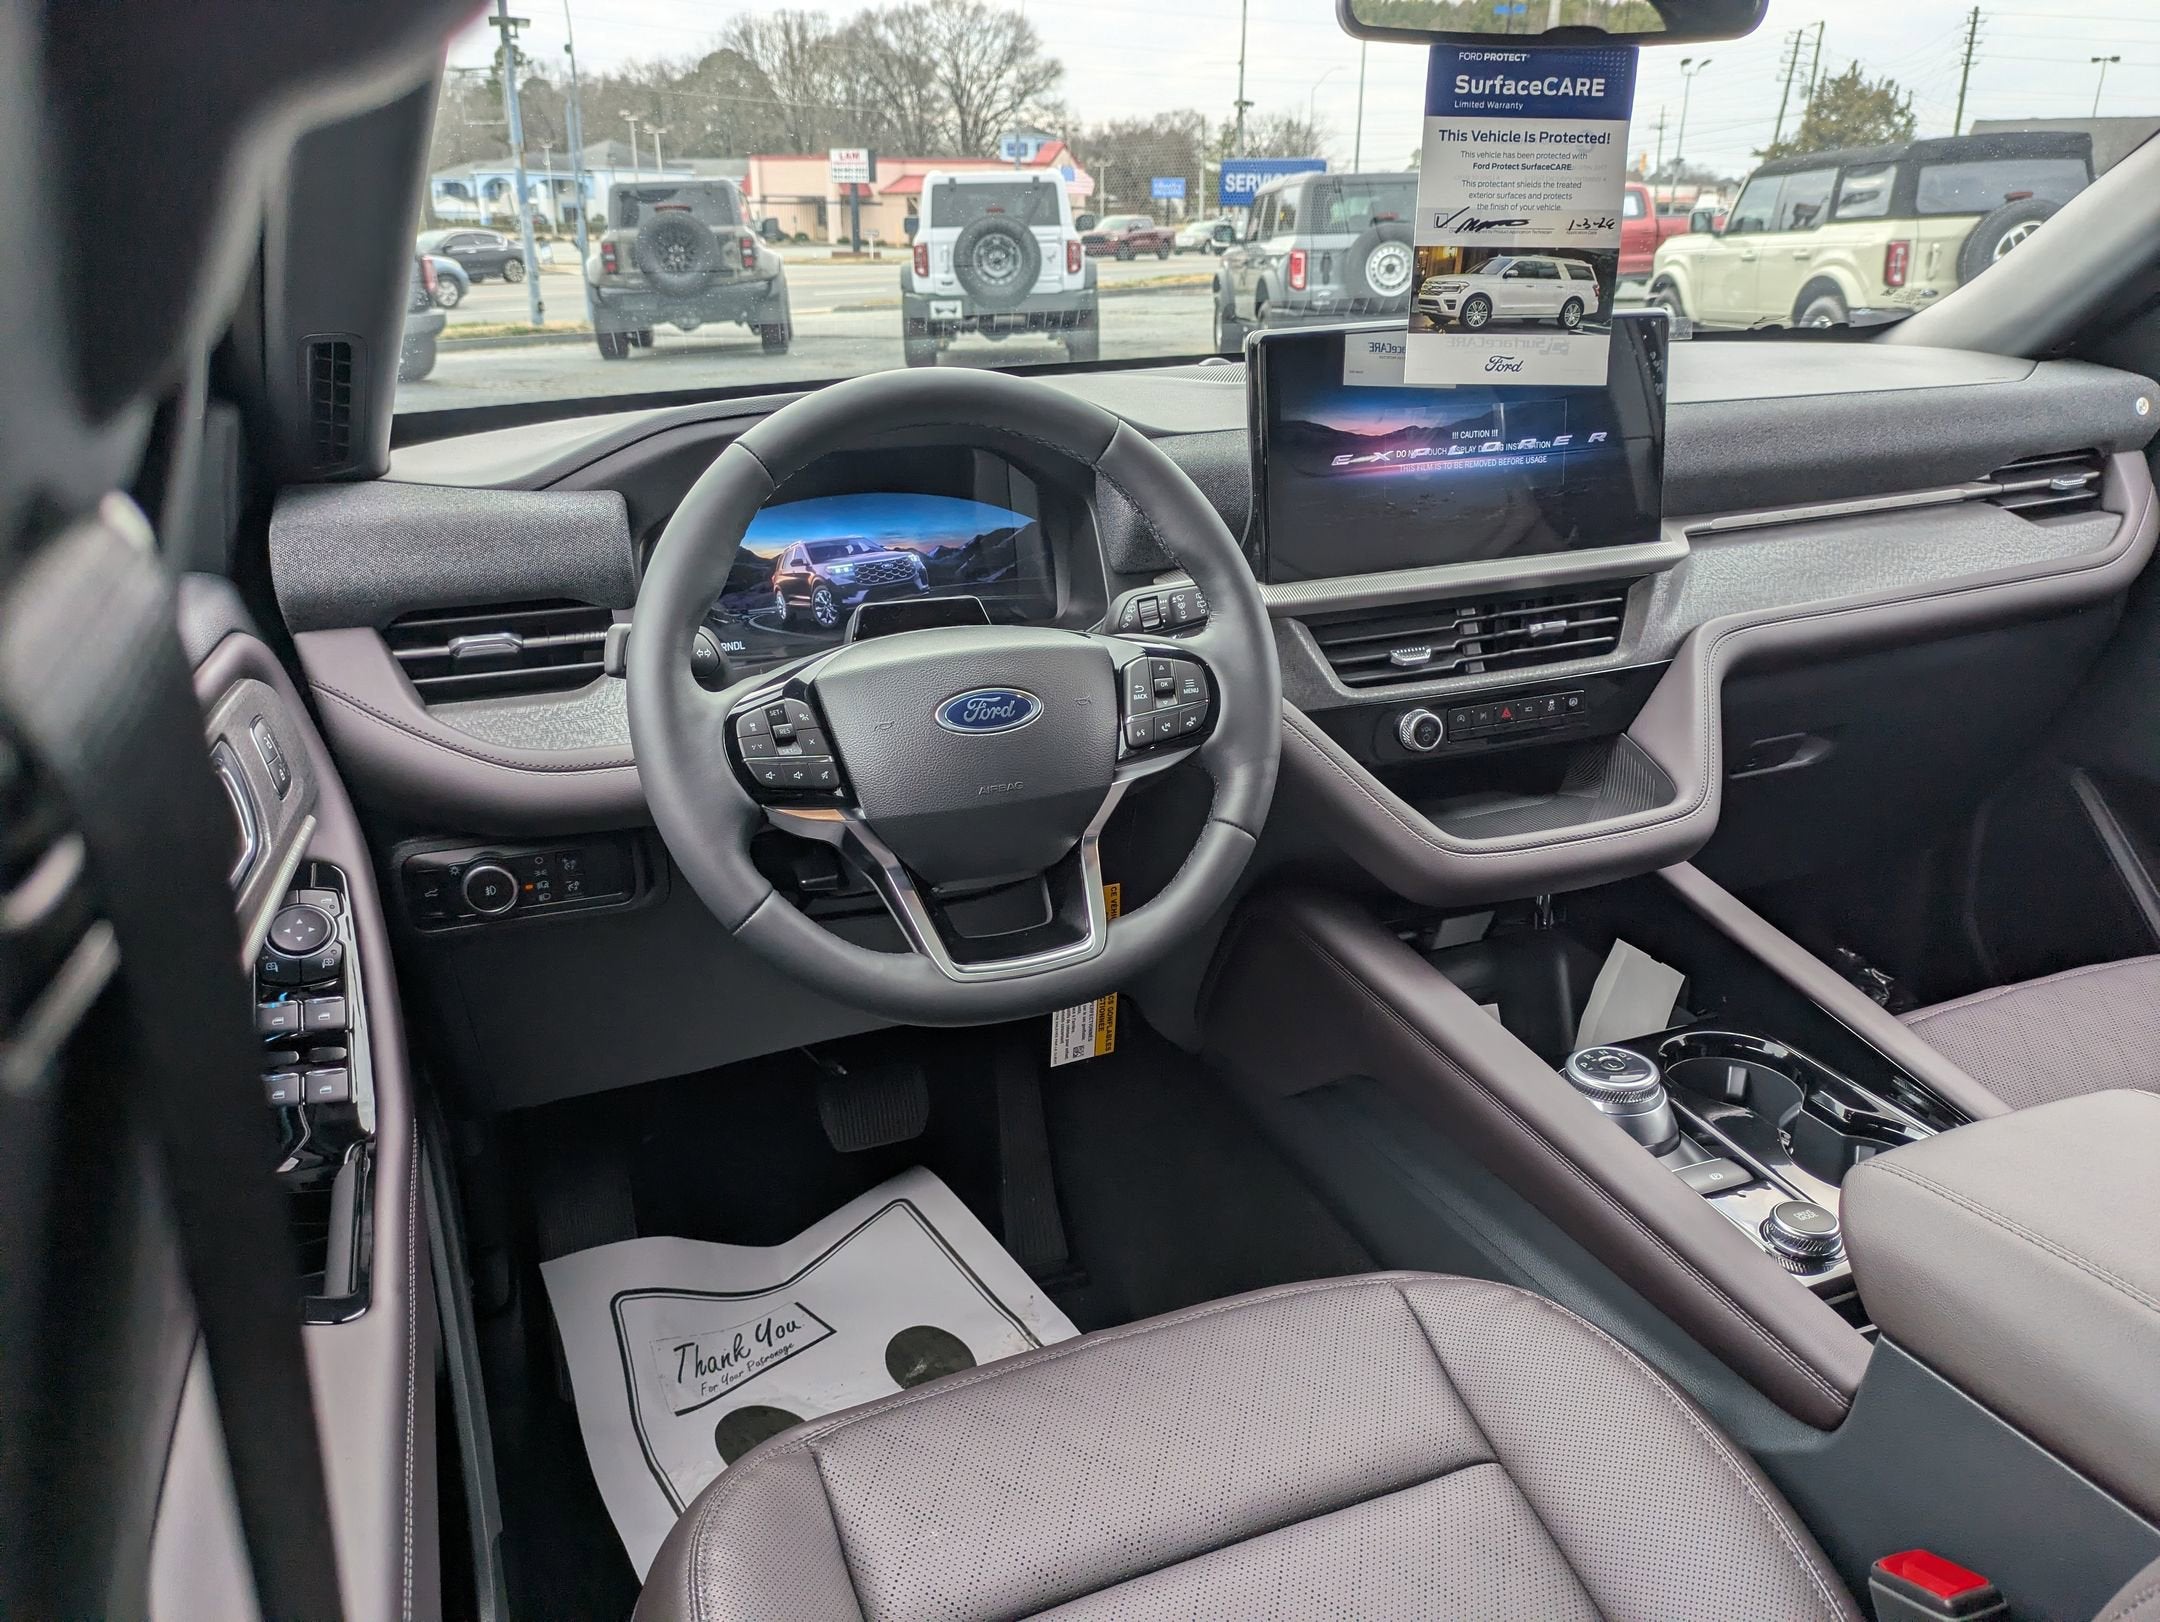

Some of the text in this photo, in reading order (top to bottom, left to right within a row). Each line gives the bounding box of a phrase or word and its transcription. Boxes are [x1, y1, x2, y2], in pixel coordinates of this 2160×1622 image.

[1458, 52, 1482, 61] FORD
[1454, 75, 1606, 97] SurfaceCARE
[1454, 101, 1524, 110] Limited Warranty
[1439, 129, 1611, 145] This Vehicle Is Protected!
[1461, 151, 1475, 159] This
[1476, 151, 1501, 159] vehicle
[1502, 151, 1516, 159] has
[1536, 152, 1571, 160] protected
[1572, 152, 1588, 160] with
[1472, 162, 1491, 170] Ford
[1462, 180, 1582, 189] This protectant shields the treated
[1468, 192, 1573, 201] exterior surfaces and protects
[1477, 203, 1489, 211] the
[1490, 203, 1509, 211] finish
[1510, 203, 1518, 211] of
[1484, 355, 1524, 373] Ford
[1460, 429, 1490, 439] CAUTION
[1331, 432, 1608, 466] EXPLORER
[1396, 450, 1407, 458] DO
[1424, 447, 1447, 456] OUCH
[1400, 464, 1415, 473] THIS
[1434, 462, 1442, 471] IS
[1443, 462, 1452, 470] TO
[1453, 461, 1463, 469] BE
[1464, 458, 1497, 469] REMOVED
[1498, 457, 1524, 466] BEFORE
[1525, 455, 1548, 464] USAGE
[1183, 687, 1199, 695] MENU
[963, 696, 1016, 723] Ford
[978, 781, 1024, 795] AIRBAG
[1110, 886, 1117, 897] CE
[1105, 1006, 1114, 1052] GONFLABLES
[673, 1317, 802, 1384] Thank You
[701, 1341, 795, 1396] For Your Patronage
